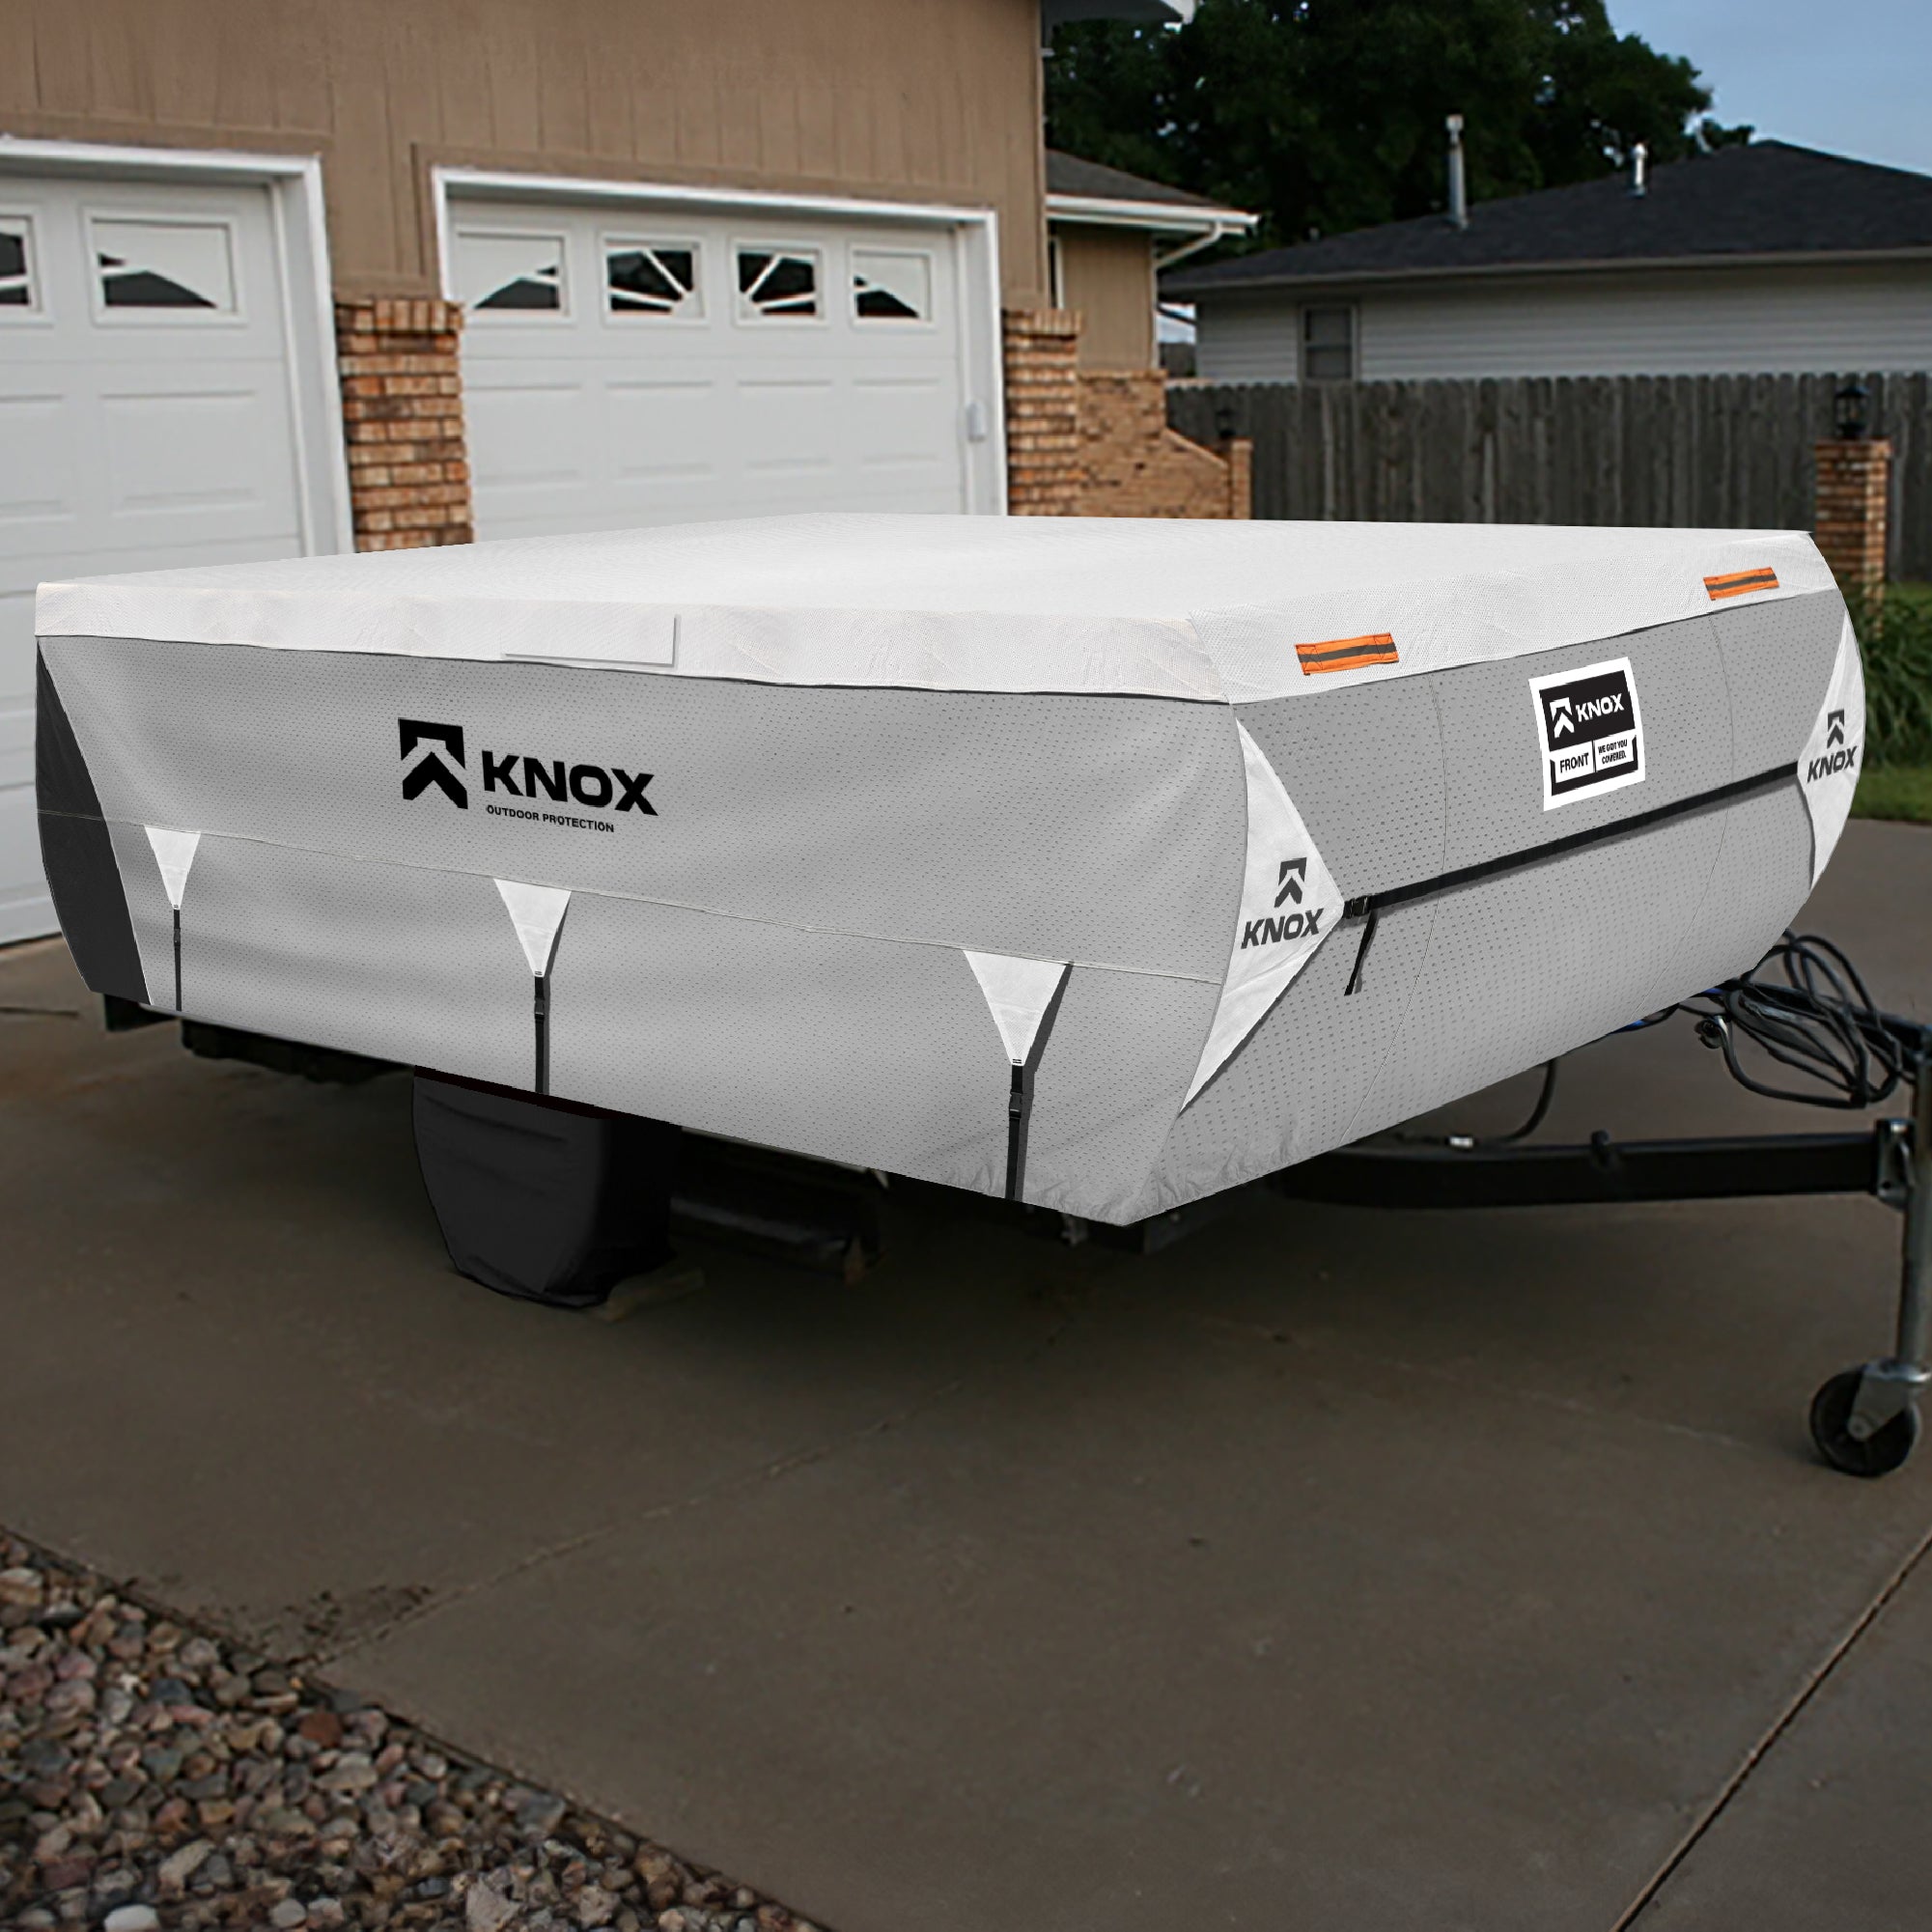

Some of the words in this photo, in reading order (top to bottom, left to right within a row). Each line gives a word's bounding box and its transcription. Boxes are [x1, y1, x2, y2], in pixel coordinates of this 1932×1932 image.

[1576, 693, 1625, 722] KNOX
[1598, 744, 1606, 754] WE
[1607, 742, 1617, 751] GOT
[1617, 739, 1627, 748] YOU
[1560, 752, 1589, 772] FRONT
[1806, 745, 1858, 783] KNOX
[482, 749, 658, 816] KNOX
[486, 804, 540, 821] OUTDOOR
[543, 813, 614, 832] PROTECTION
[1241, 908, 1324, 949] KNOX
